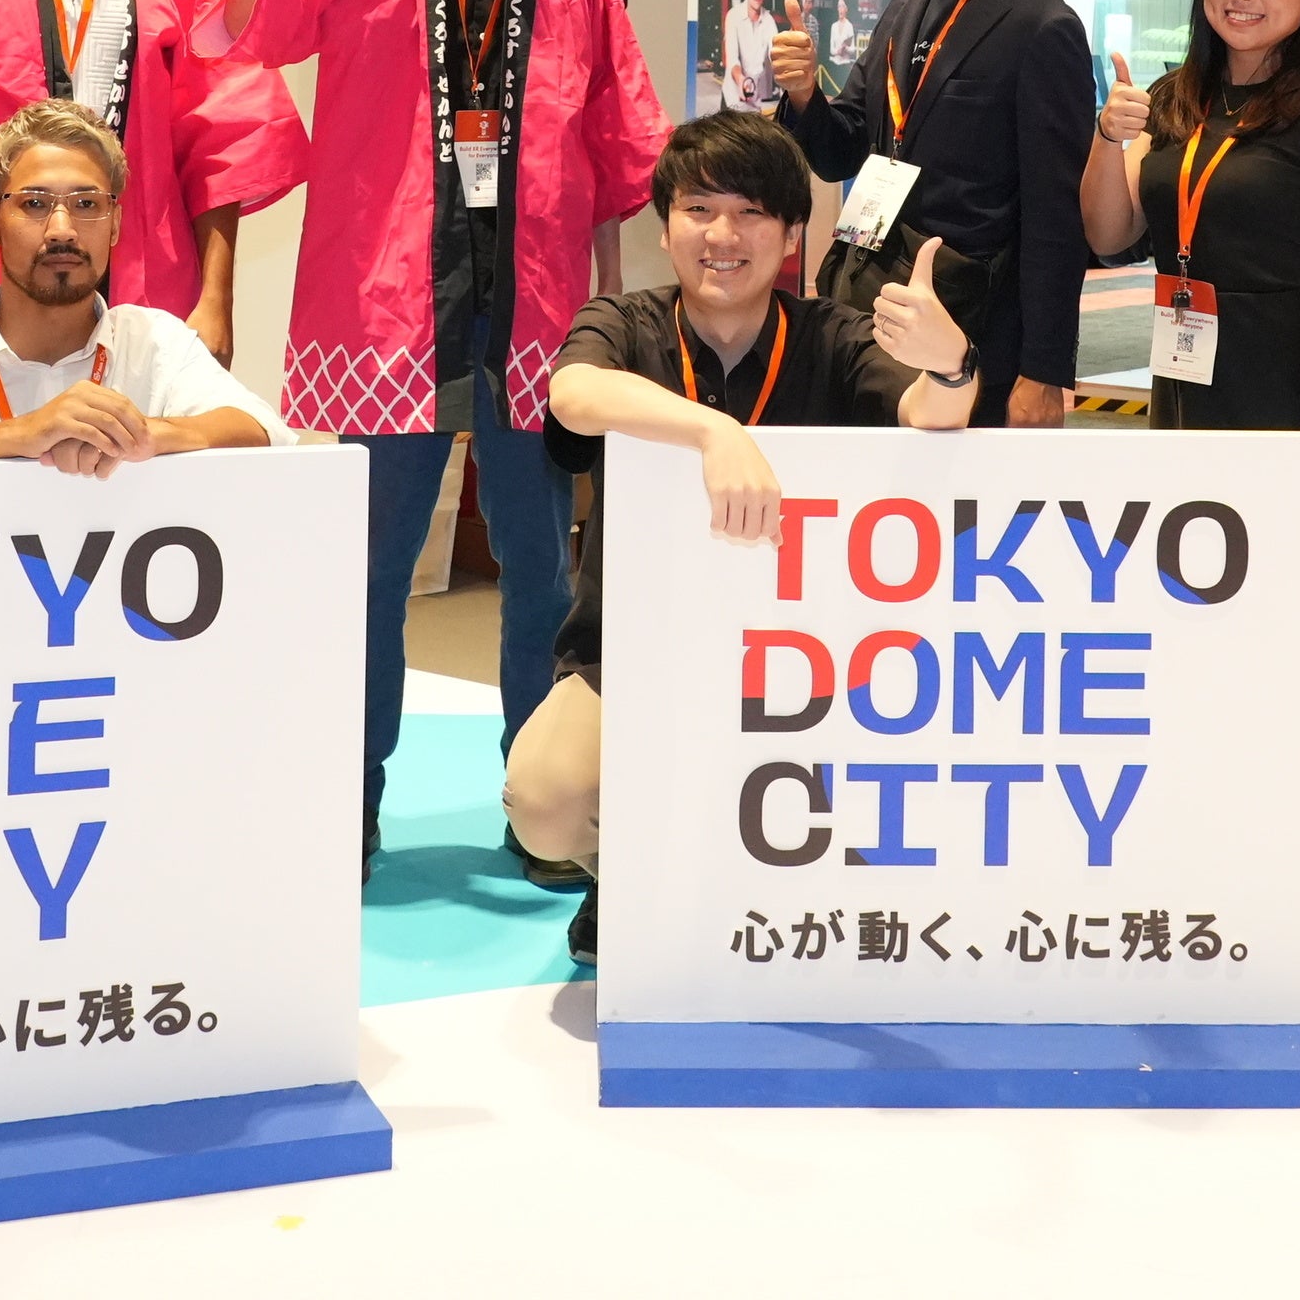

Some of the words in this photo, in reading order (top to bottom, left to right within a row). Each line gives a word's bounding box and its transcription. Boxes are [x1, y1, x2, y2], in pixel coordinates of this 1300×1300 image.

[776, 497, 1249, 605] TOKYO
[741, 629, 1152, 735] DOME
[739, 761, 1148, 867] CITY
[730, 909, 1249, 963] 心が動く、心に残る。
